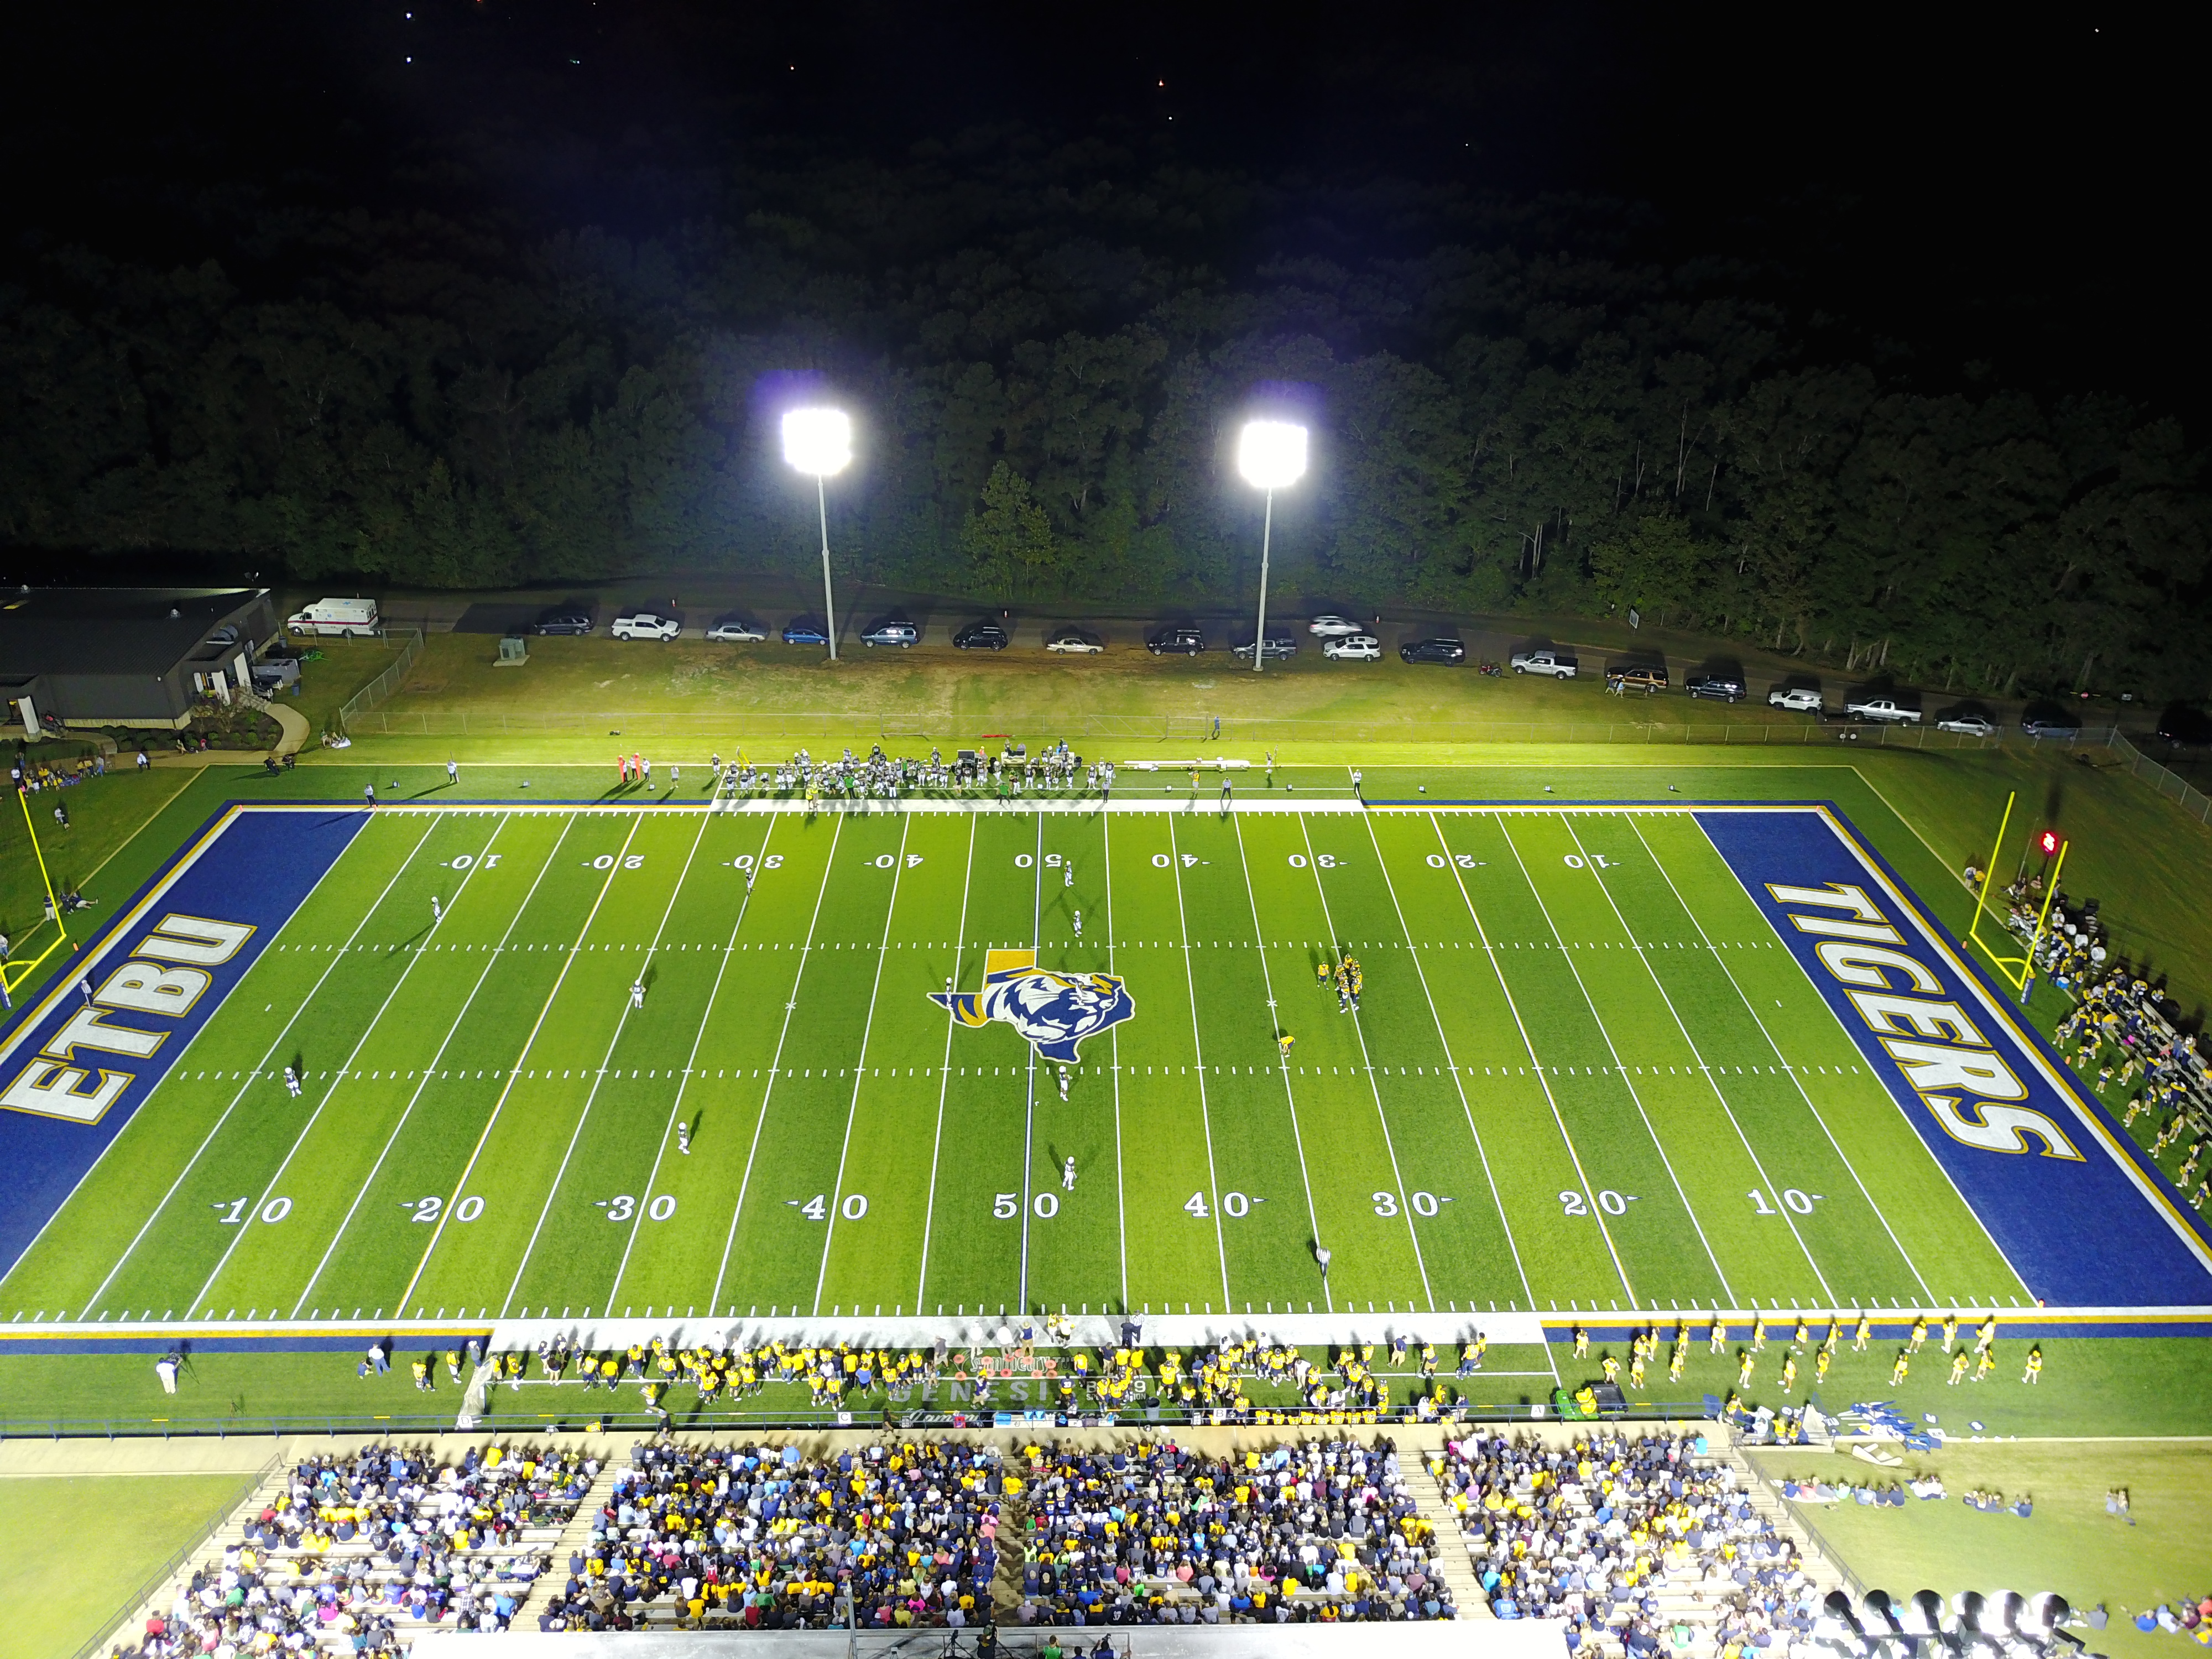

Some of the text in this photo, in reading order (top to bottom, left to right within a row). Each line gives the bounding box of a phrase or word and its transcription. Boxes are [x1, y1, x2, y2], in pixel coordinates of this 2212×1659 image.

[451, 854, 503, 870] 10
[593, 854, 645, 870] 20
[733, 854, 785, 869] 30
[875, 854, 924, 869] 40
[1014, 853, 1062, 868] 50
[1151, 853, 1199, 868] 40
[1287, 854, 1337, 869] 30
[1425, 854, 1477, 869] 20
[1563, 854, 1610, 869] 10
[0, 913, 258, 1125] ETBU
[1764, 882, 2087, 1162] TIGERS
[219, 1197, 293, 1223] 10
[411, 1196, 485, 1223] 20
[607, 1194, 676, 1222] 30
[801, 1194, 868, 1220] 40
[993, 1192, 1059, 1219] 50
[1183, 1191, 1249, 1218] 40
[1371, 1191, 1439, 1217] 30
[1558, 1190, 1627, 1216] 20
[1747, 1188, 1813, 1215] 10
[892, 1381, 1076, 1402] GENESI
[840, 1413, 848, 1421] C
